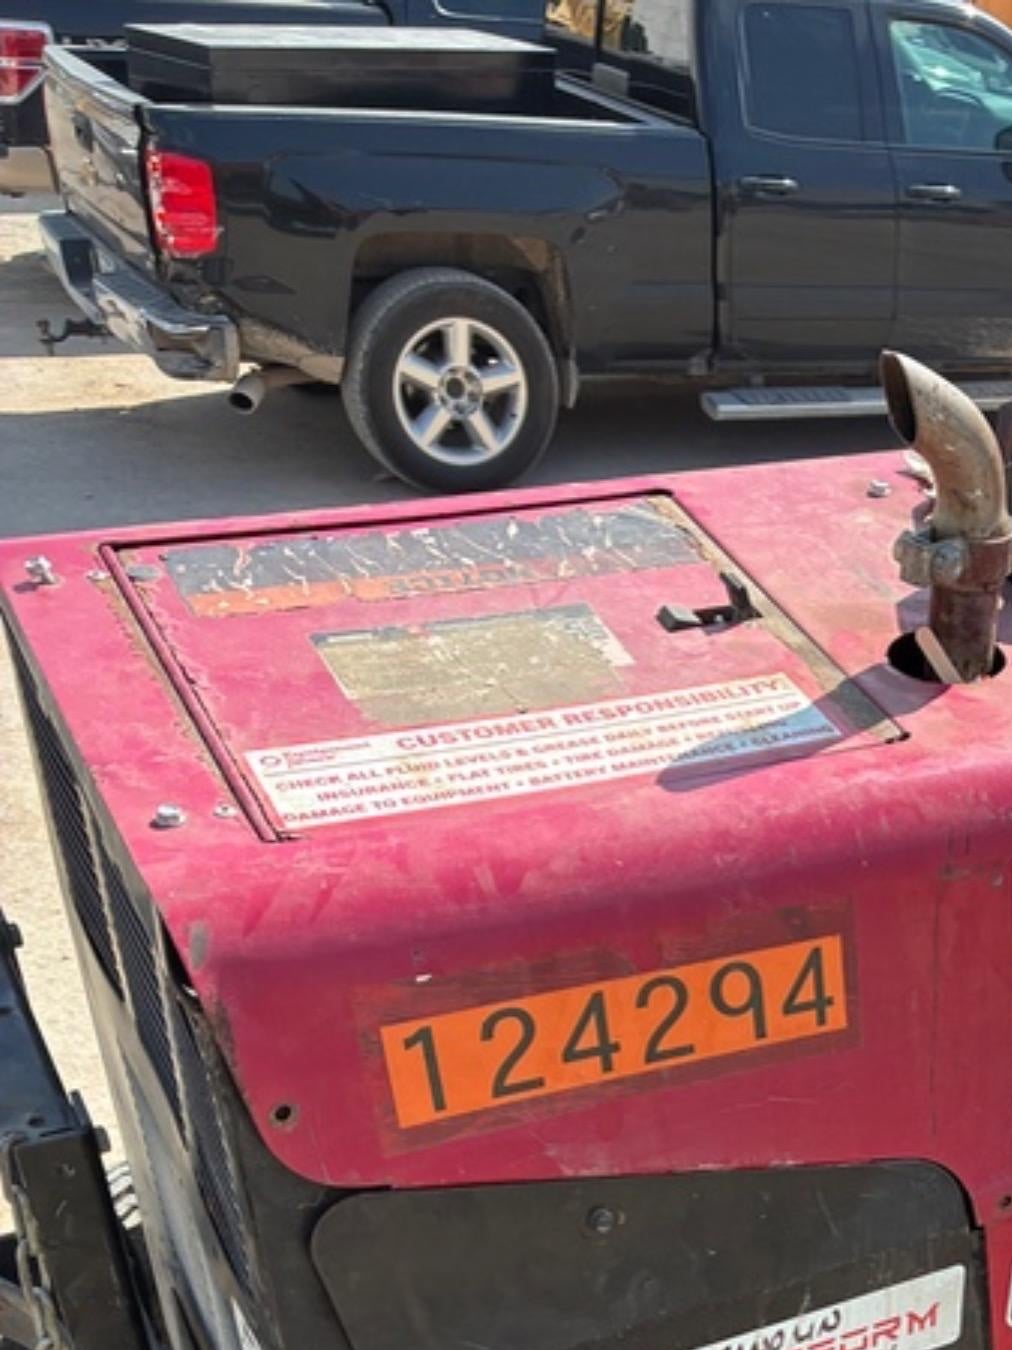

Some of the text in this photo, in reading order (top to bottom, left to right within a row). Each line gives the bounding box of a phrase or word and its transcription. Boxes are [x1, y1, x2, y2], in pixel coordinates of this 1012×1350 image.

[275, 774, 342, 793] CHECK
[347, 768, 382, 782] ALL
[385, 760, 439, 776] FLUID
[443, 749, 513, 769] LEVELS
[533, 735, 600, 756] GREASE
[656, 714, 721, 734] BEFORE
[724, 704, 776, 722] START
[778, 700, 801, 712] UP
[397, 716, 556, 750] CUSTOMER
[283, 802, 367, 823] DAMAGE
[372, 795, 397, 811] TO
[400, 781, 511, 807] EQUIPMENT
[529, 765, 607, 787] BATTERY
[316, 737, 679, 803] INSURANCE FLAT TIRES TIRE DAMAGE
[403, 946, 835, 1111] 124294
